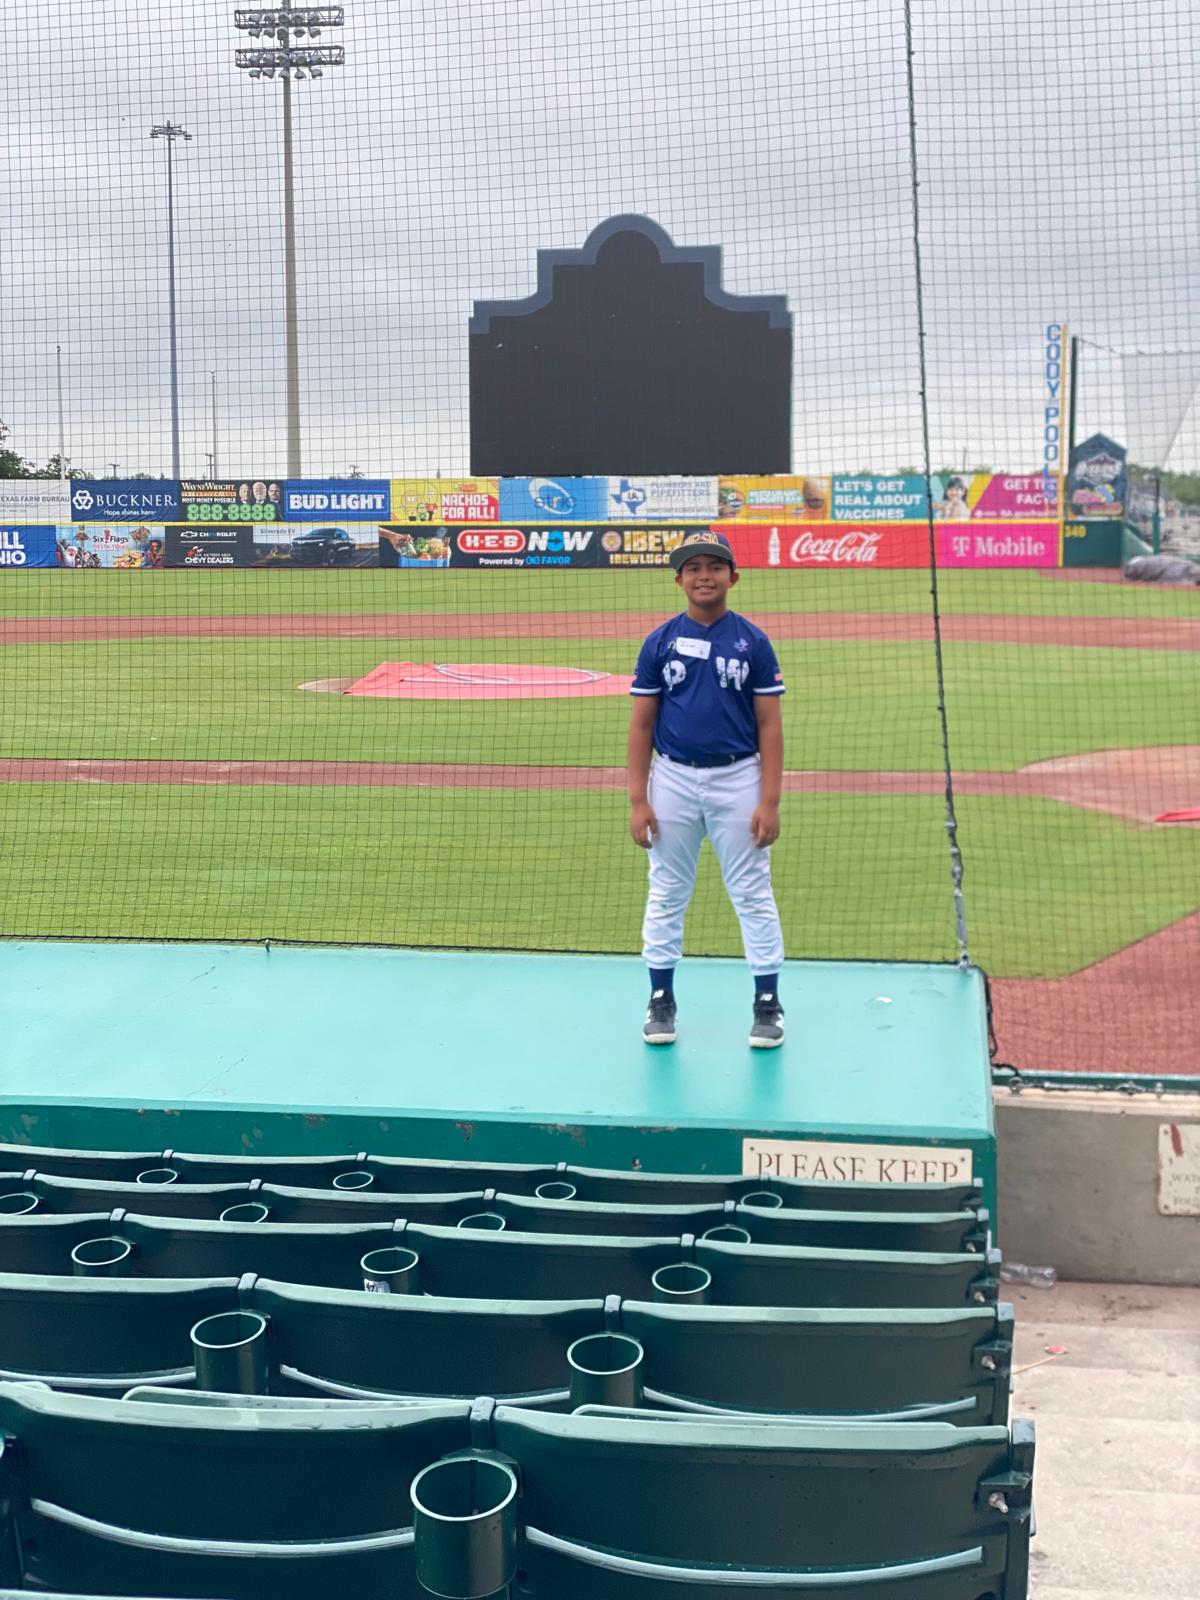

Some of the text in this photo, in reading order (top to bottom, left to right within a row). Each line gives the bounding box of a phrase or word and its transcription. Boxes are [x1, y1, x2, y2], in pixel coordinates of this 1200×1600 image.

[1046, 324, 1061, 397] CODY
[835, 480, 905, 492] LET'S GET
[1004, 479, 1030, 490] GET
[96, 494, 173, 506] BUCKNER
[289, 494, 385, 509] BUD LIGHT
[441, 494, 488, 506] NACHOS
[834, 494, 922, 505] REAL ABOUT
[187, 503, 276, 521] 888-8888
[441, 506, 495, 519] FOR ALL!
[835, 508, 904, 519] VACCINES
[110, 536, 129, 544] Flags
[528, 531, 593, 552] NOW
[624, 530, 685, 552] IBEW
[975, 536, 1045, 557] Mobile
[514, 558, 524, 567] by
[541, 556, 571, 565] FAVOR
[757, 1152, 959, 1183] PLEASE KEEP
